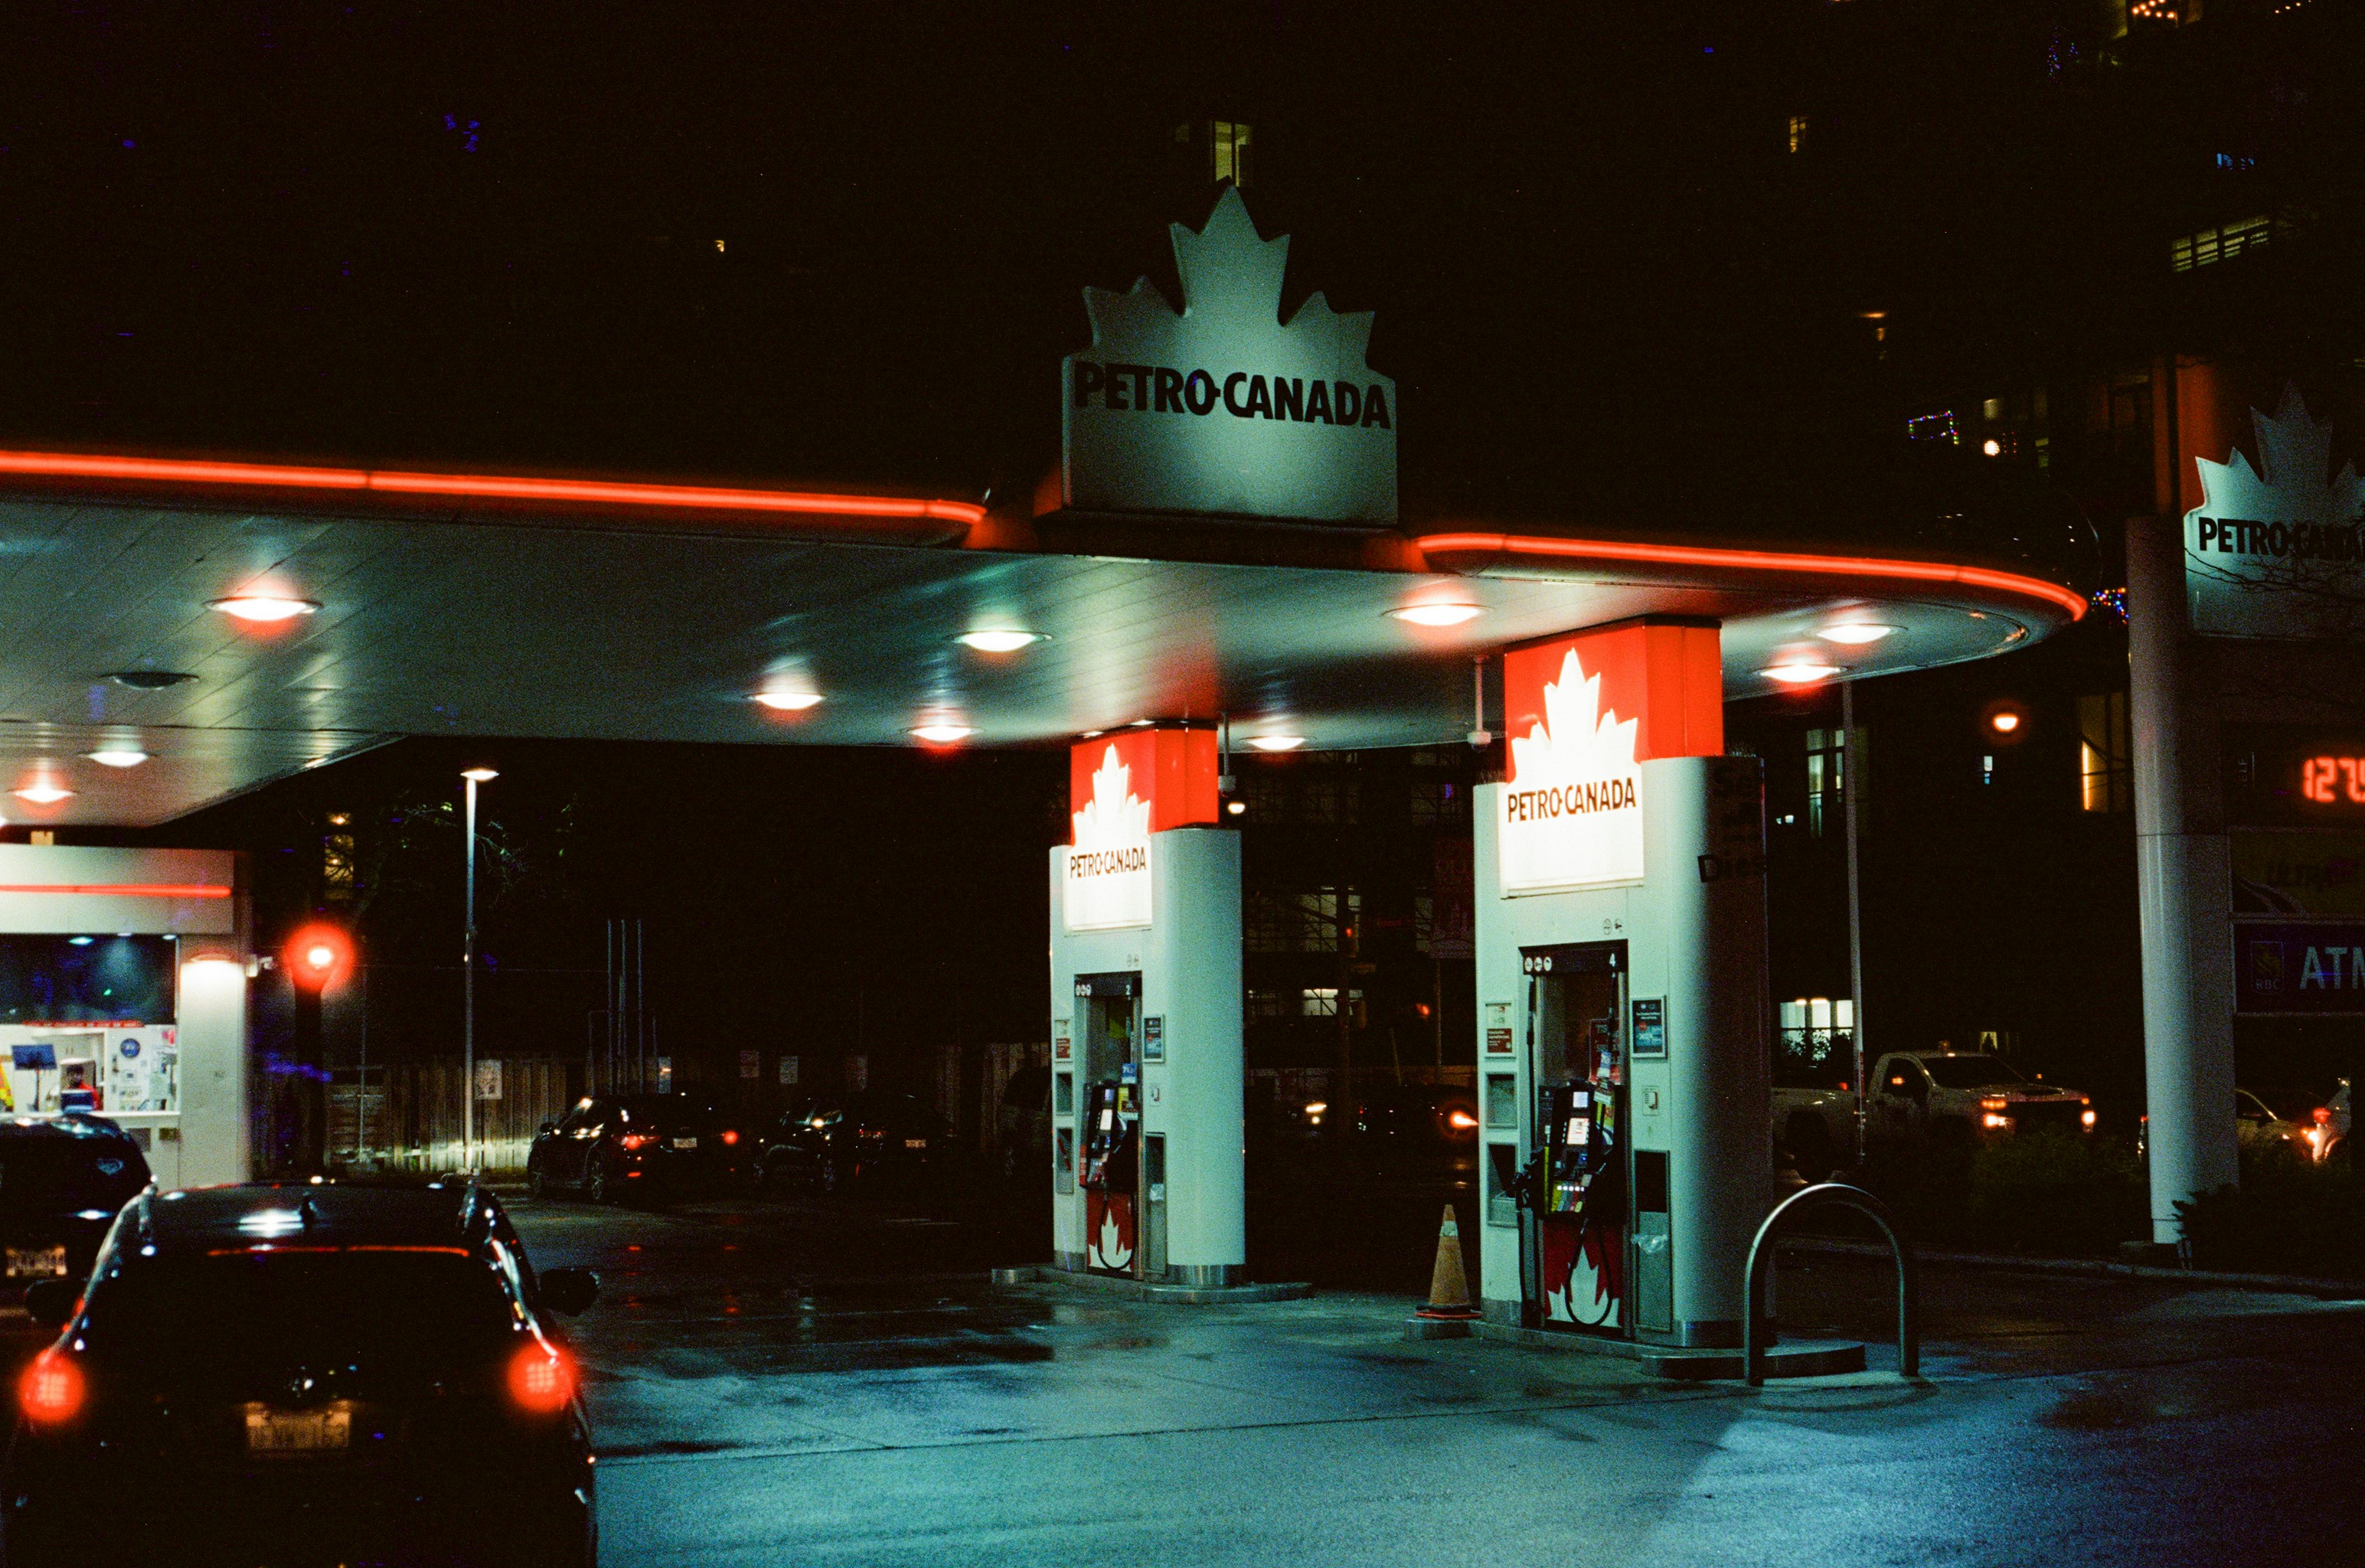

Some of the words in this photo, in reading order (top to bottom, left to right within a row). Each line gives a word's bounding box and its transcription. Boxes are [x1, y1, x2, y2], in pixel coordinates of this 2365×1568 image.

[1074, 361, 1391, 430] PETRO-CANADA
[1508, 776, 1637, 824] PETRO-CANADA
[1070, 846, 1147, 879] PETRO-CANADA
[1609, 952, 1616, 967] 4
